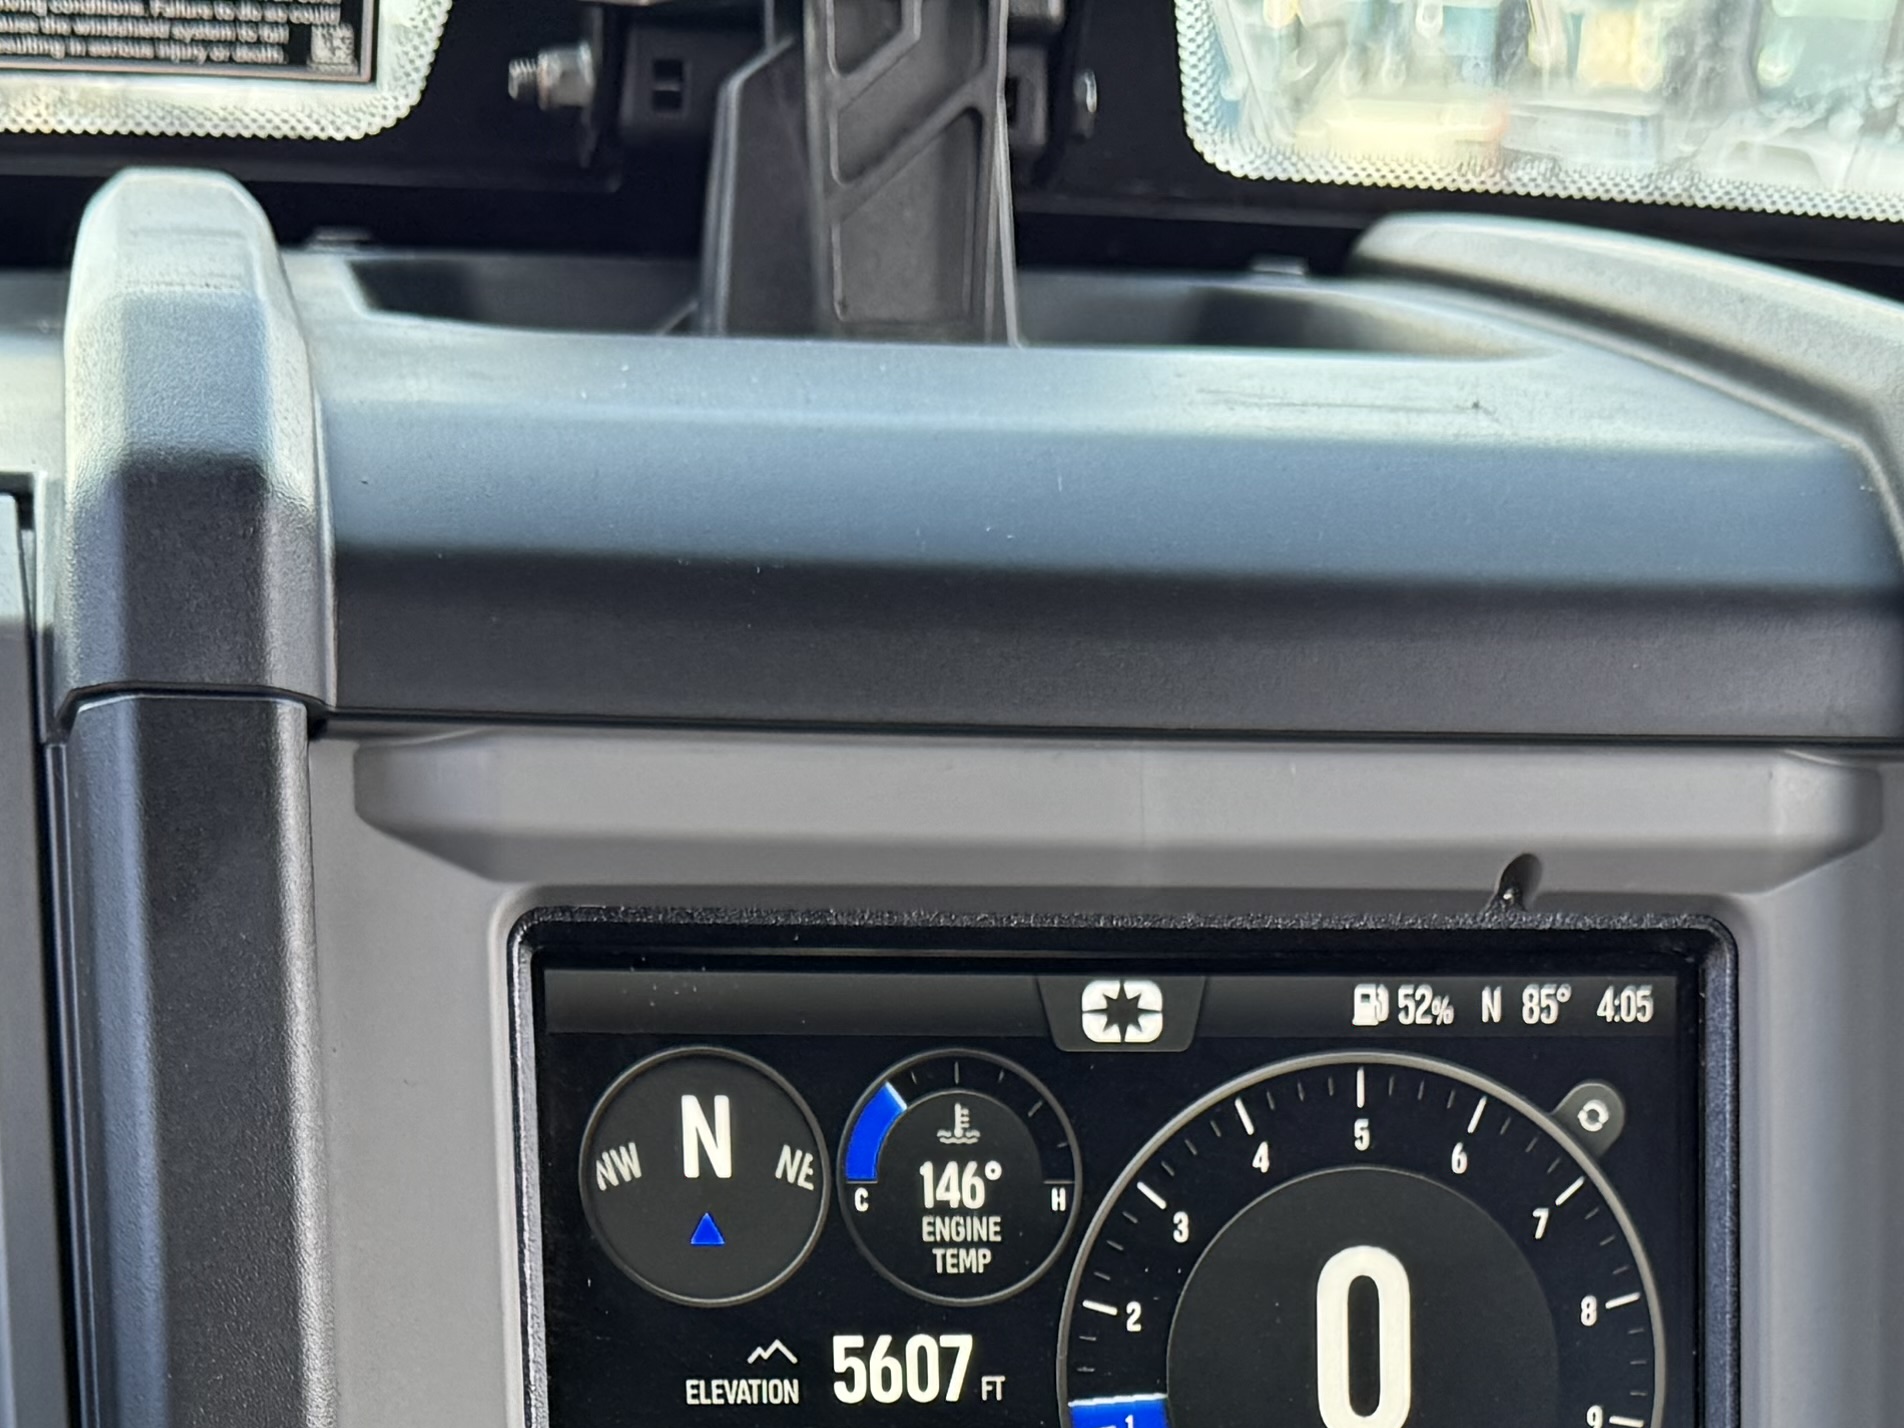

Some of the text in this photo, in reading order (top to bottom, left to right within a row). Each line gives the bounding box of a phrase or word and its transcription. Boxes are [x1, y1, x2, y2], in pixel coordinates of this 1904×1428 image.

[1397, 983, 1654, 1026] 52% N 85° 4:05
[681, 1094, 732, 1179] N
[1354, 1118, 1370, 1151] 5
[596, 1142, 642, 1191] NW
[774, 1144, 814, 1191] NE
[1252, 1141, 1270, 1173] 4
[1451, 1142, 1468, 1174] 6
[854, 1187, 869, 1212] C
[919, 1160, 1003, 1210] 146°
[1051, 1187, 1067, 1212] H
[922, 1215, 1002, 1242] ENGINE
[1173, 1211, 1189, 1243] 3
[1532, 1207, 1549, 1239] 7
[931, 1247, 992, 1274] TEMP
[1126, 1301, 1142, 1332] 2
[1580, 1295, 1597, 1327] 8
[832, 1333, 1006, 1404] 5607 FT
[685, 1378, 800, 1405] ELEVATION
